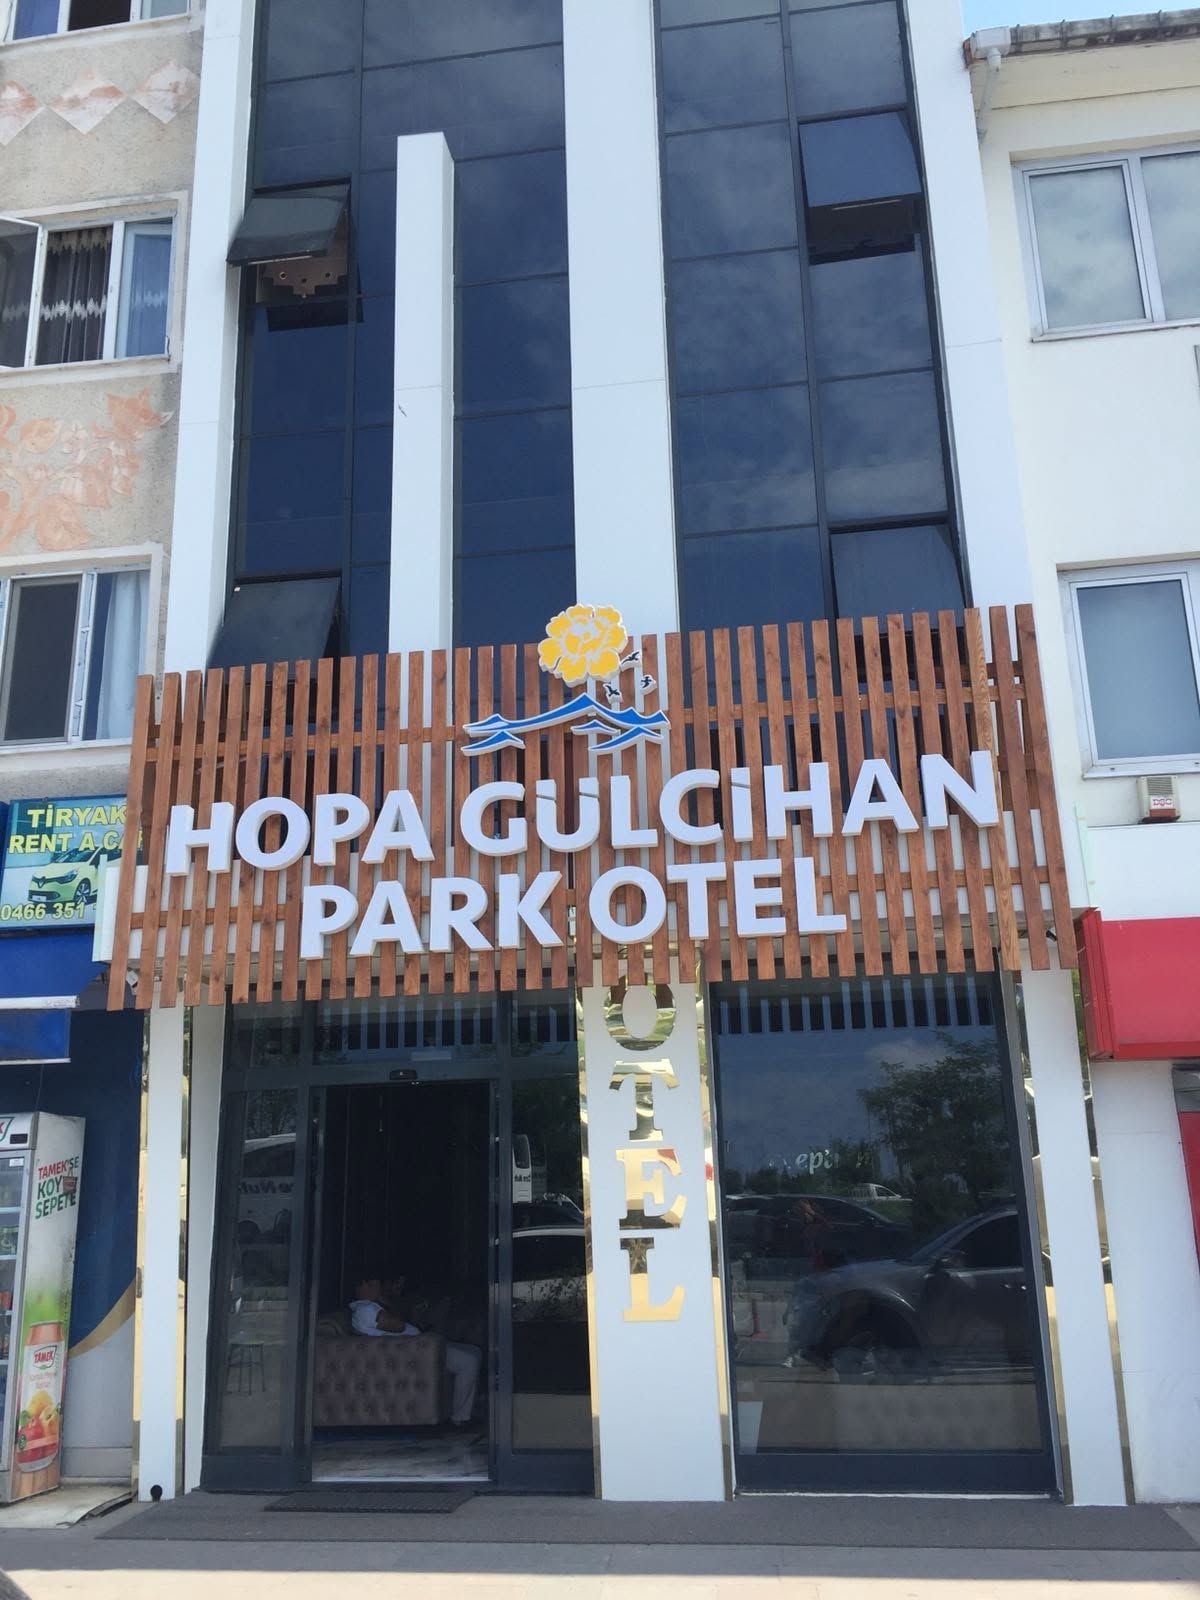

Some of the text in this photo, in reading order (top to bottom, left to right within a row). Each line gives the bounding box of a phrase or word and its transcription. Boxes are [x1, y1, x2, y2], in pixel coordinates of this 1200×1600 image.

[8, 832, 74, 854] RENT
[78, 832, 96, 851] A
[165, 789, 435, 877] HOPA
[1, 901, 86, 921] 0466 351
[300, 856, 847, 961] PARK OTEL
[603, 972, 688, 1322] OTEL
[37, 1175, 63, 1200] KOY
[35, 1191, 76, 1219] SEPETE
